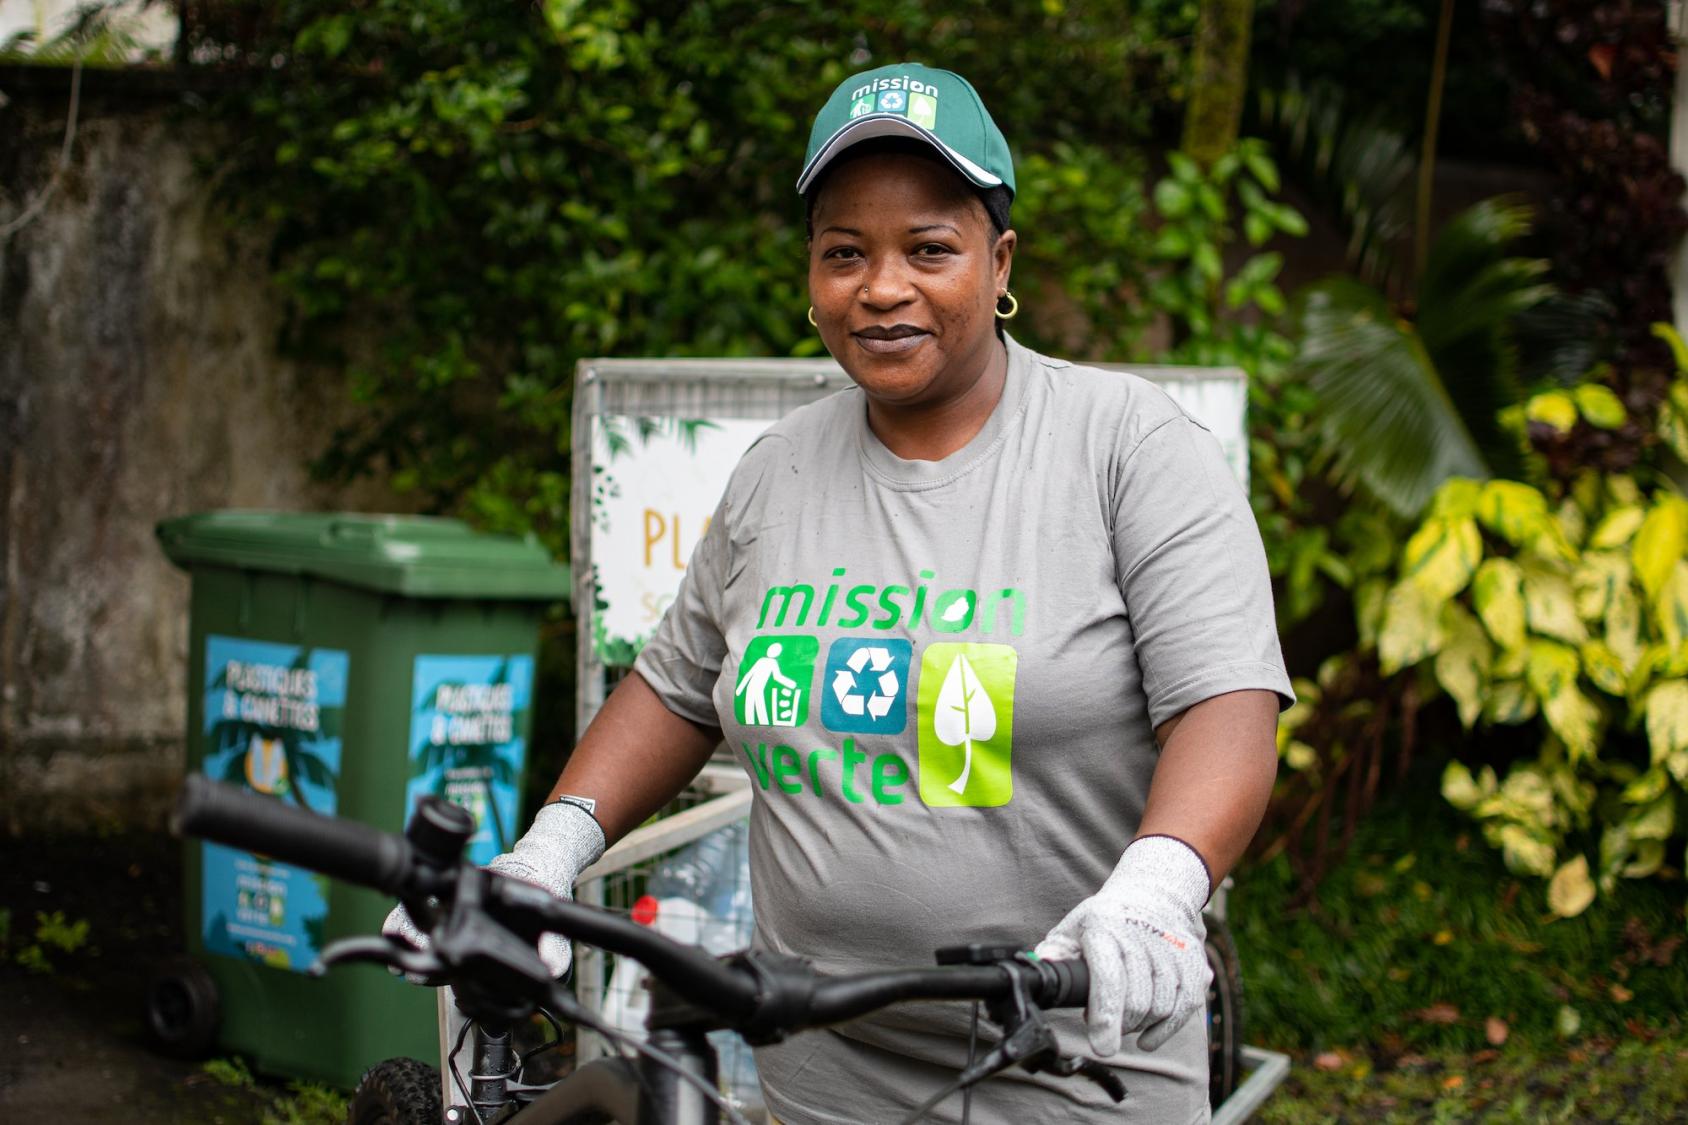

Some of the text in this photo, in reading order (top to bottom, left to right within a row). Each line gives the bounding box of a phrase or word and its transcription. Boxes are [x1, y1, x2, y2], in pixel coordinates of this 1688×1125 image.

[852, 76, 938, 100] mission
[642, 507, 712, 571] PL
[756, 567, 1027, 636] mission
[742, 738, 909, 805] verte
